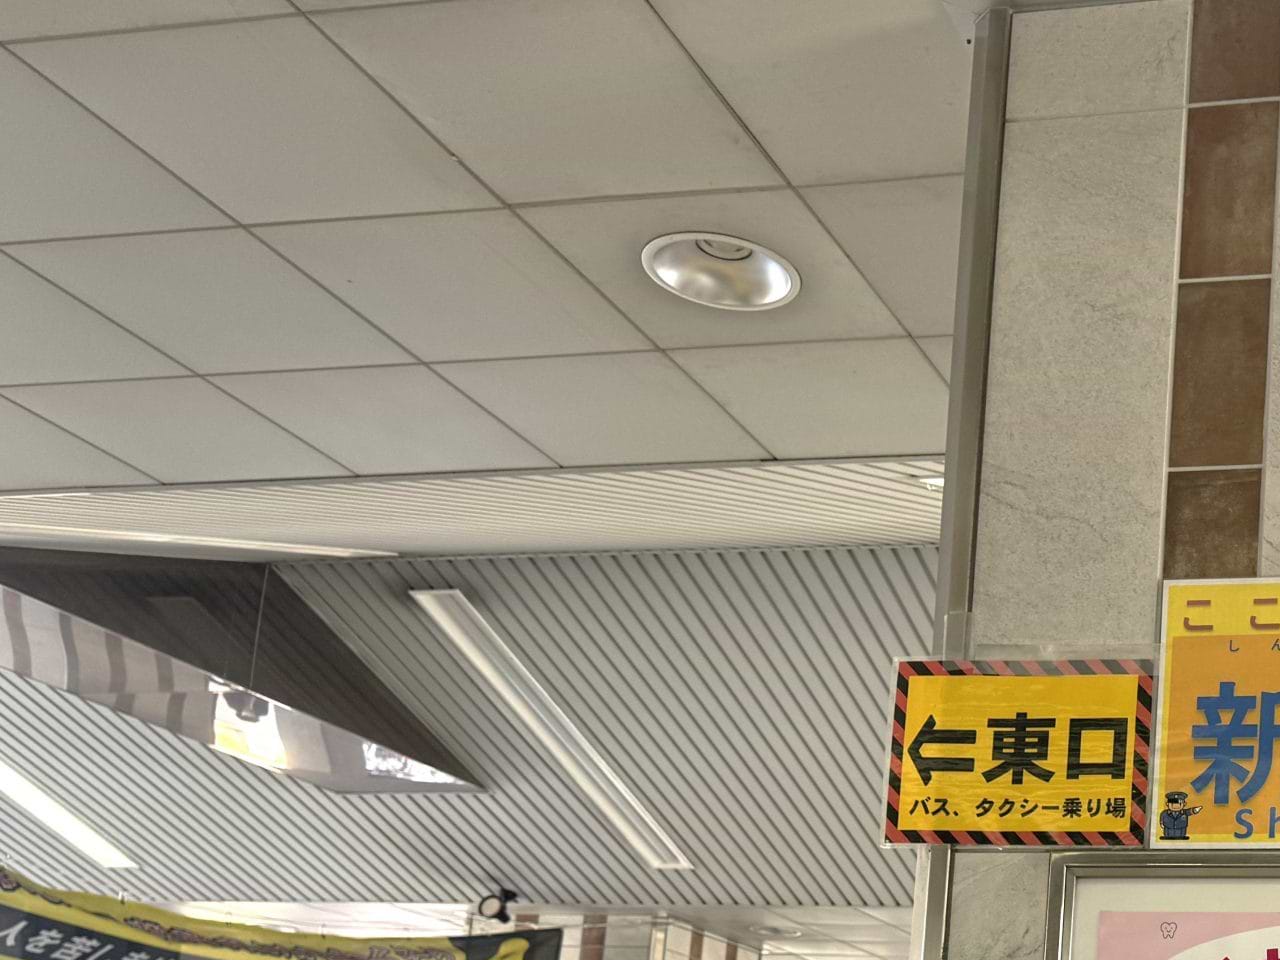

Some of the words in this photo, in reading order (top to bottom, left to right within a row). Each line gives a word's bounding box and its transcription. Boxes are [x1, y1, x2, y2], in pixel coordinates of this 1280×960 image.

[983, 711, 1127, 786] 東口
[909, 796, 1128, 823] バス、タクシー乗り場
